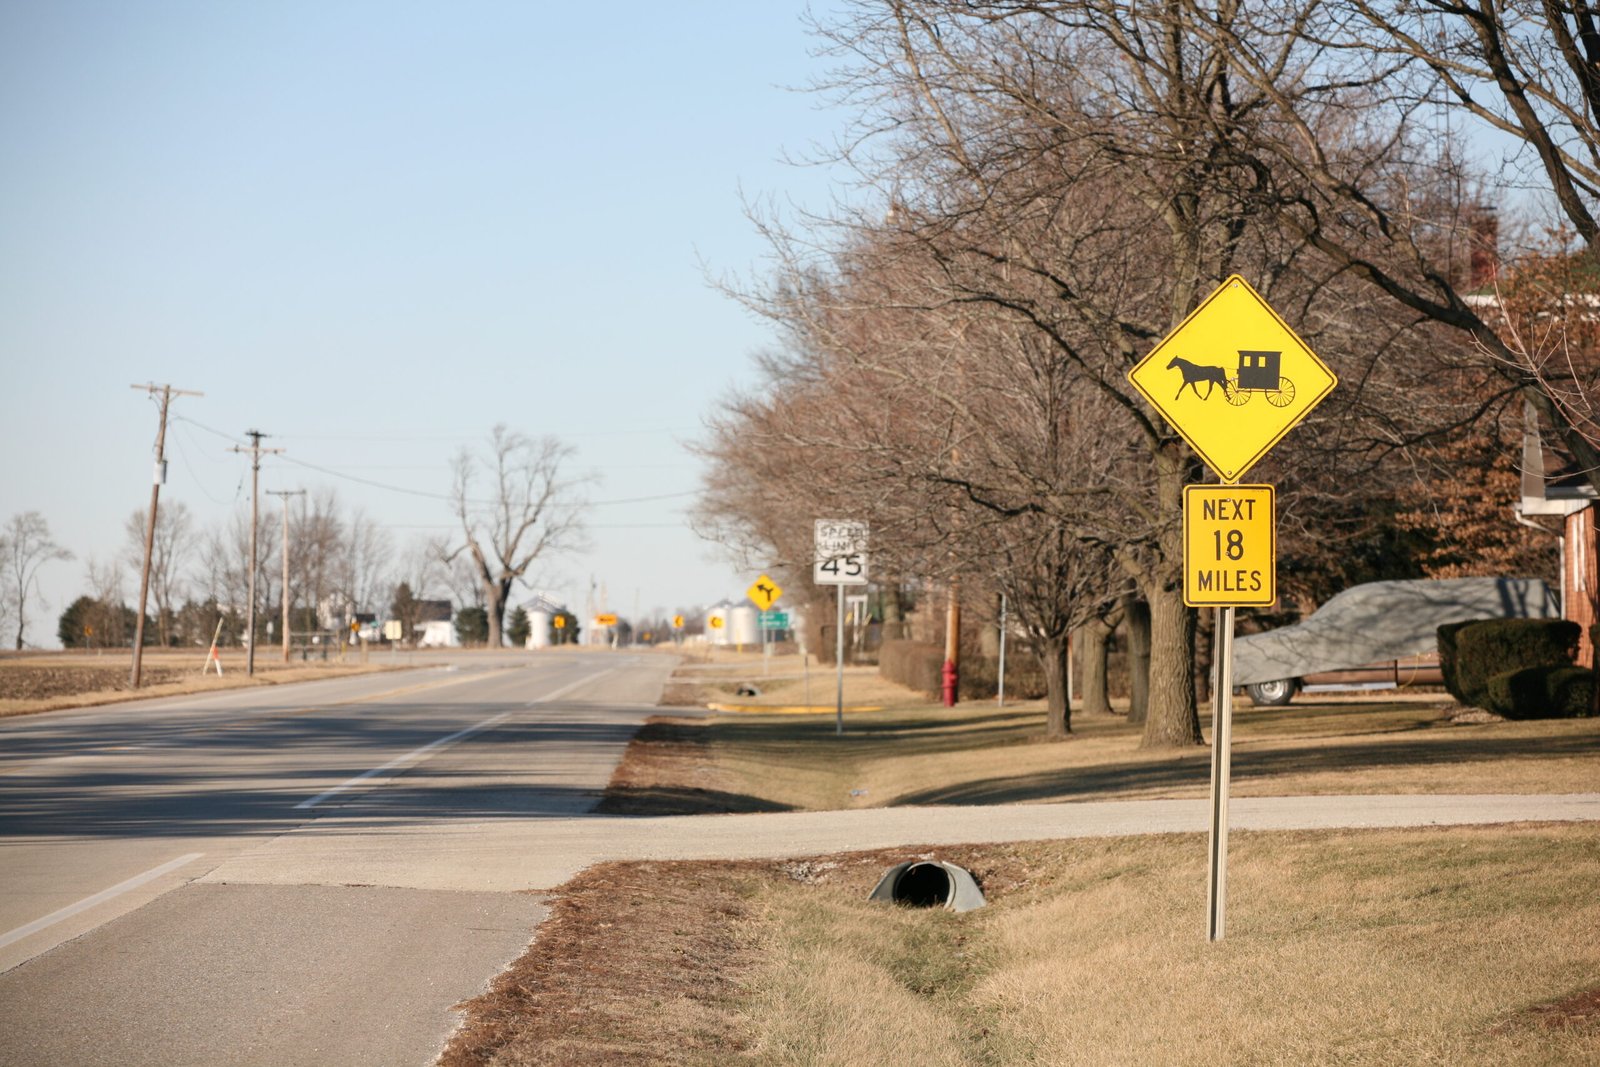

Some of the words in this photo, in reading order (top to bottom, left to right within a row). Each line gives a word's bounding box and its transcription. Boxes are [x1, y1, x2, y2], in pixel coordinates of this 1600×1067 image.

[1203, 499, 1256, 520] NEXT
[1213, 529, 1244, 561] 18
[820, 555, 862, 576] 45
[1198, 570, 1262, 592] MILES
